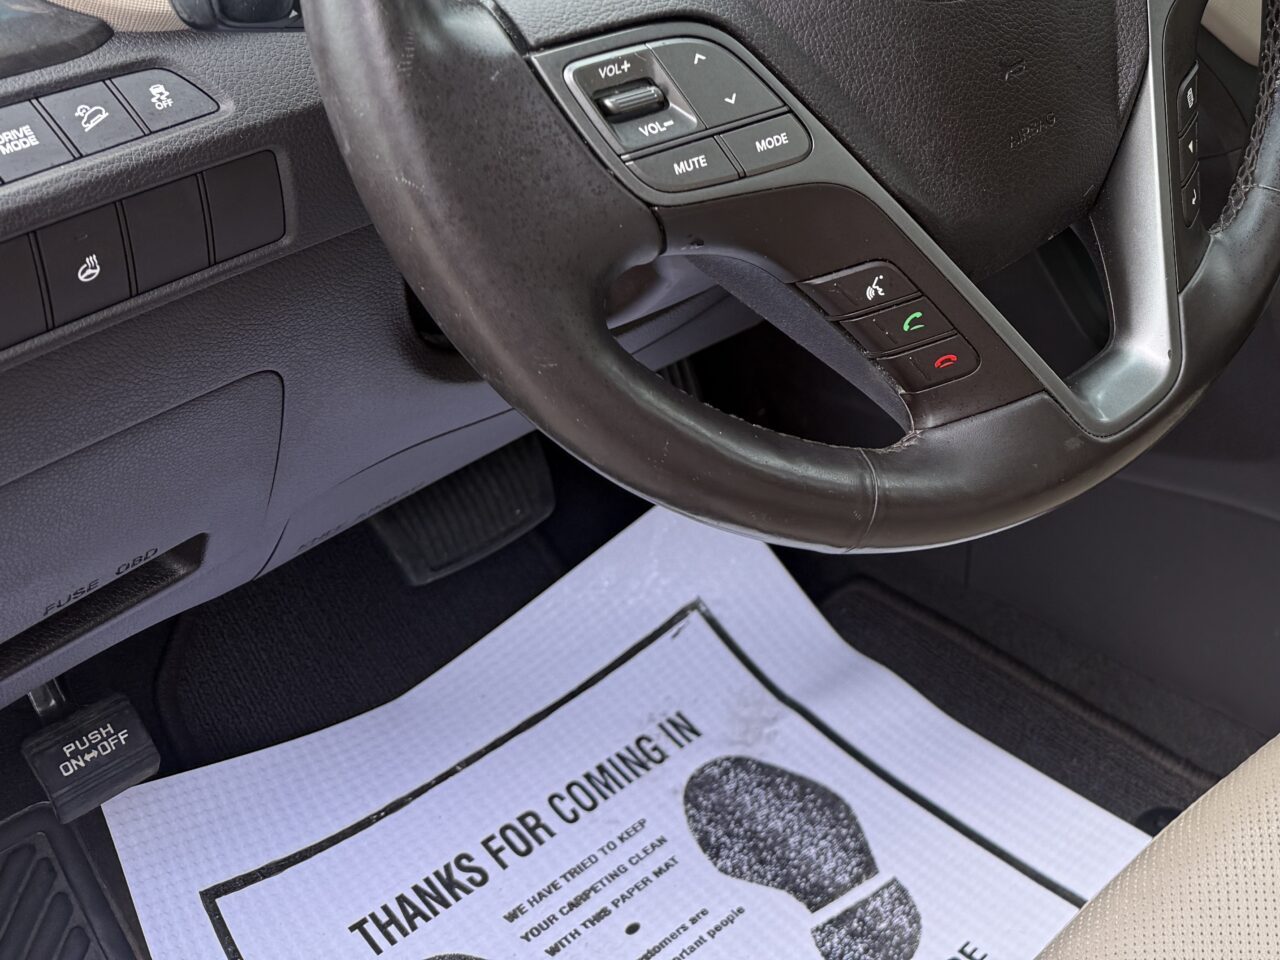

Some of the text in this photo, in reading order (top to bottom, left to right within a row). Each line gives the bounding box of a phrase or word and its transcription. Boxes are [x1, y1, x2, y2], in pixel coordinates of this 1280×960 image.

[599, 60, 631, 79] VOL+
[155, 98, 173, 110] OFF
[0, 135, 40, 155] MODE
[755, 132, 788, 152] MODE
[674, 155, 707, 175] MUTE
[44, 548, 158, 616] FUSE OBD
[62, 724, 114, 758] PUSH
[347, 710, 702, 956] THANKS FOR COMING IN
[503, 818, 647, 923] WE HAVE TRIED TO KEEP
[520, 835, 668, 942] YOUR CARPETING CLEAN
[544, 855, 679, 957] WITH THIS PAPER MAT
[688, 907, 709, 925] are
[706, 906, 746, 939] people
